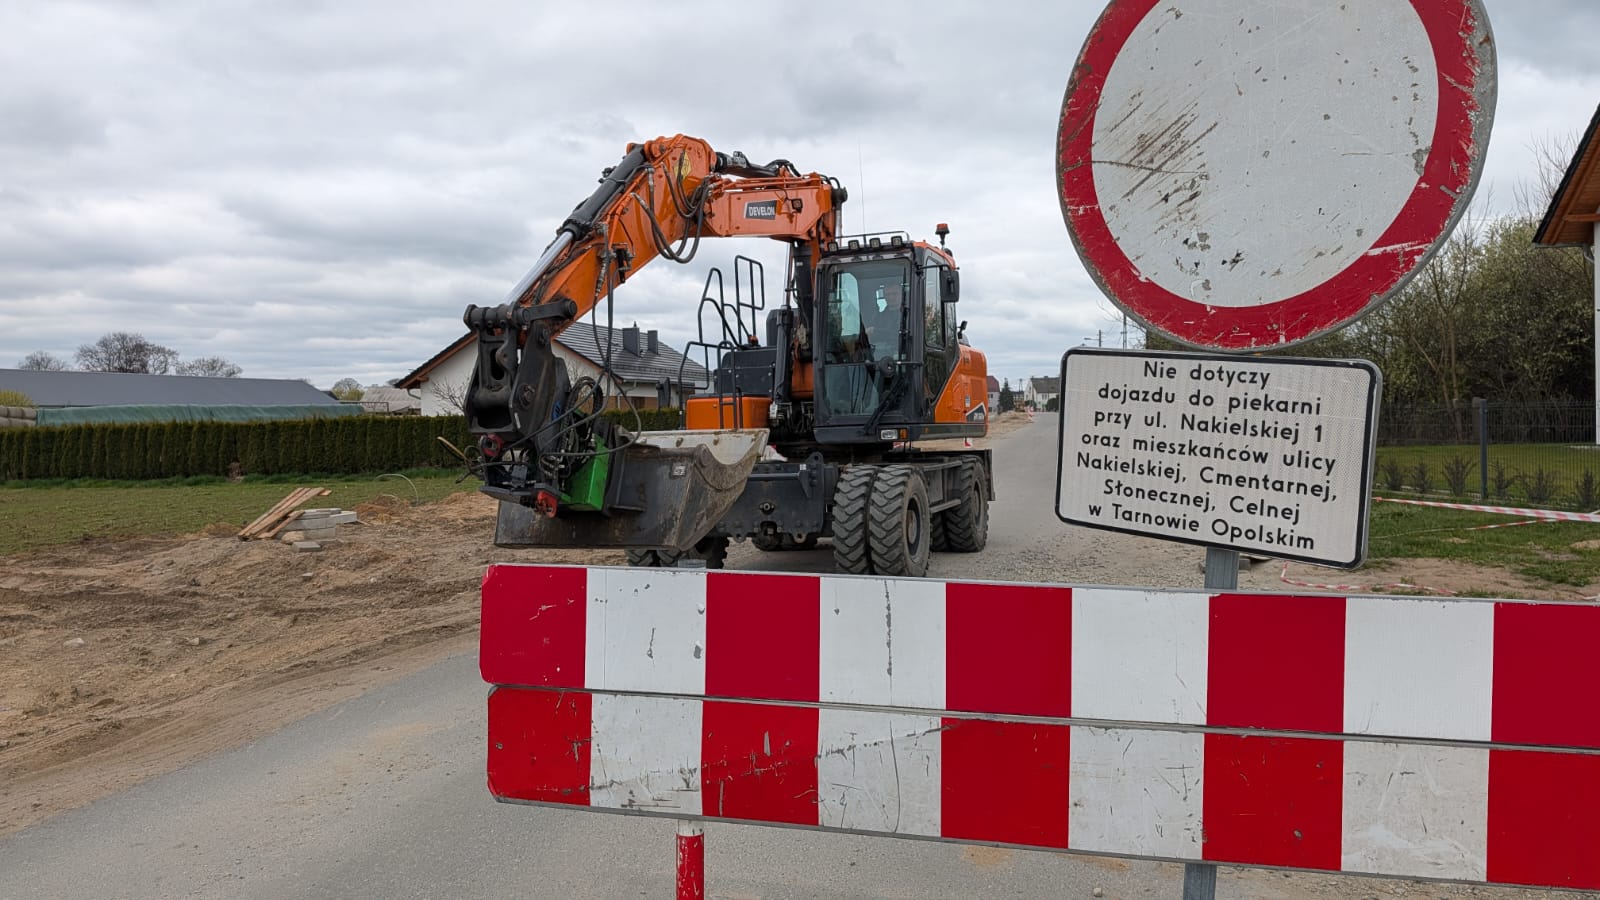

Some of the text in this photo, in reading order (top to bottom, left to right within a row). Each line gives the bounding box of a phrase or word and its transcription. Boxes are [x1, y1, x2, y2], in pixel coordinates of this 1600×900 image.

[748, 206, 775, 216] DEVELON
[1144, 360, 1271, 390] Nie dotyczy
[1098, 383, 1321, 416] dojazdu do piekarni
[1094, 411, 1323, 445] przy ul. Nakielskiej 1
[1081, 434, 1336, 476] oraz mieszkańców ulicy
[1077, 452, 1337, 503] Nakielskiej, Cmentarnej,
[1103, 478, 1300, 526] Słonecznej, Celnej
[1088, 502, 1315, 550] w Tarnowie Opolskim
